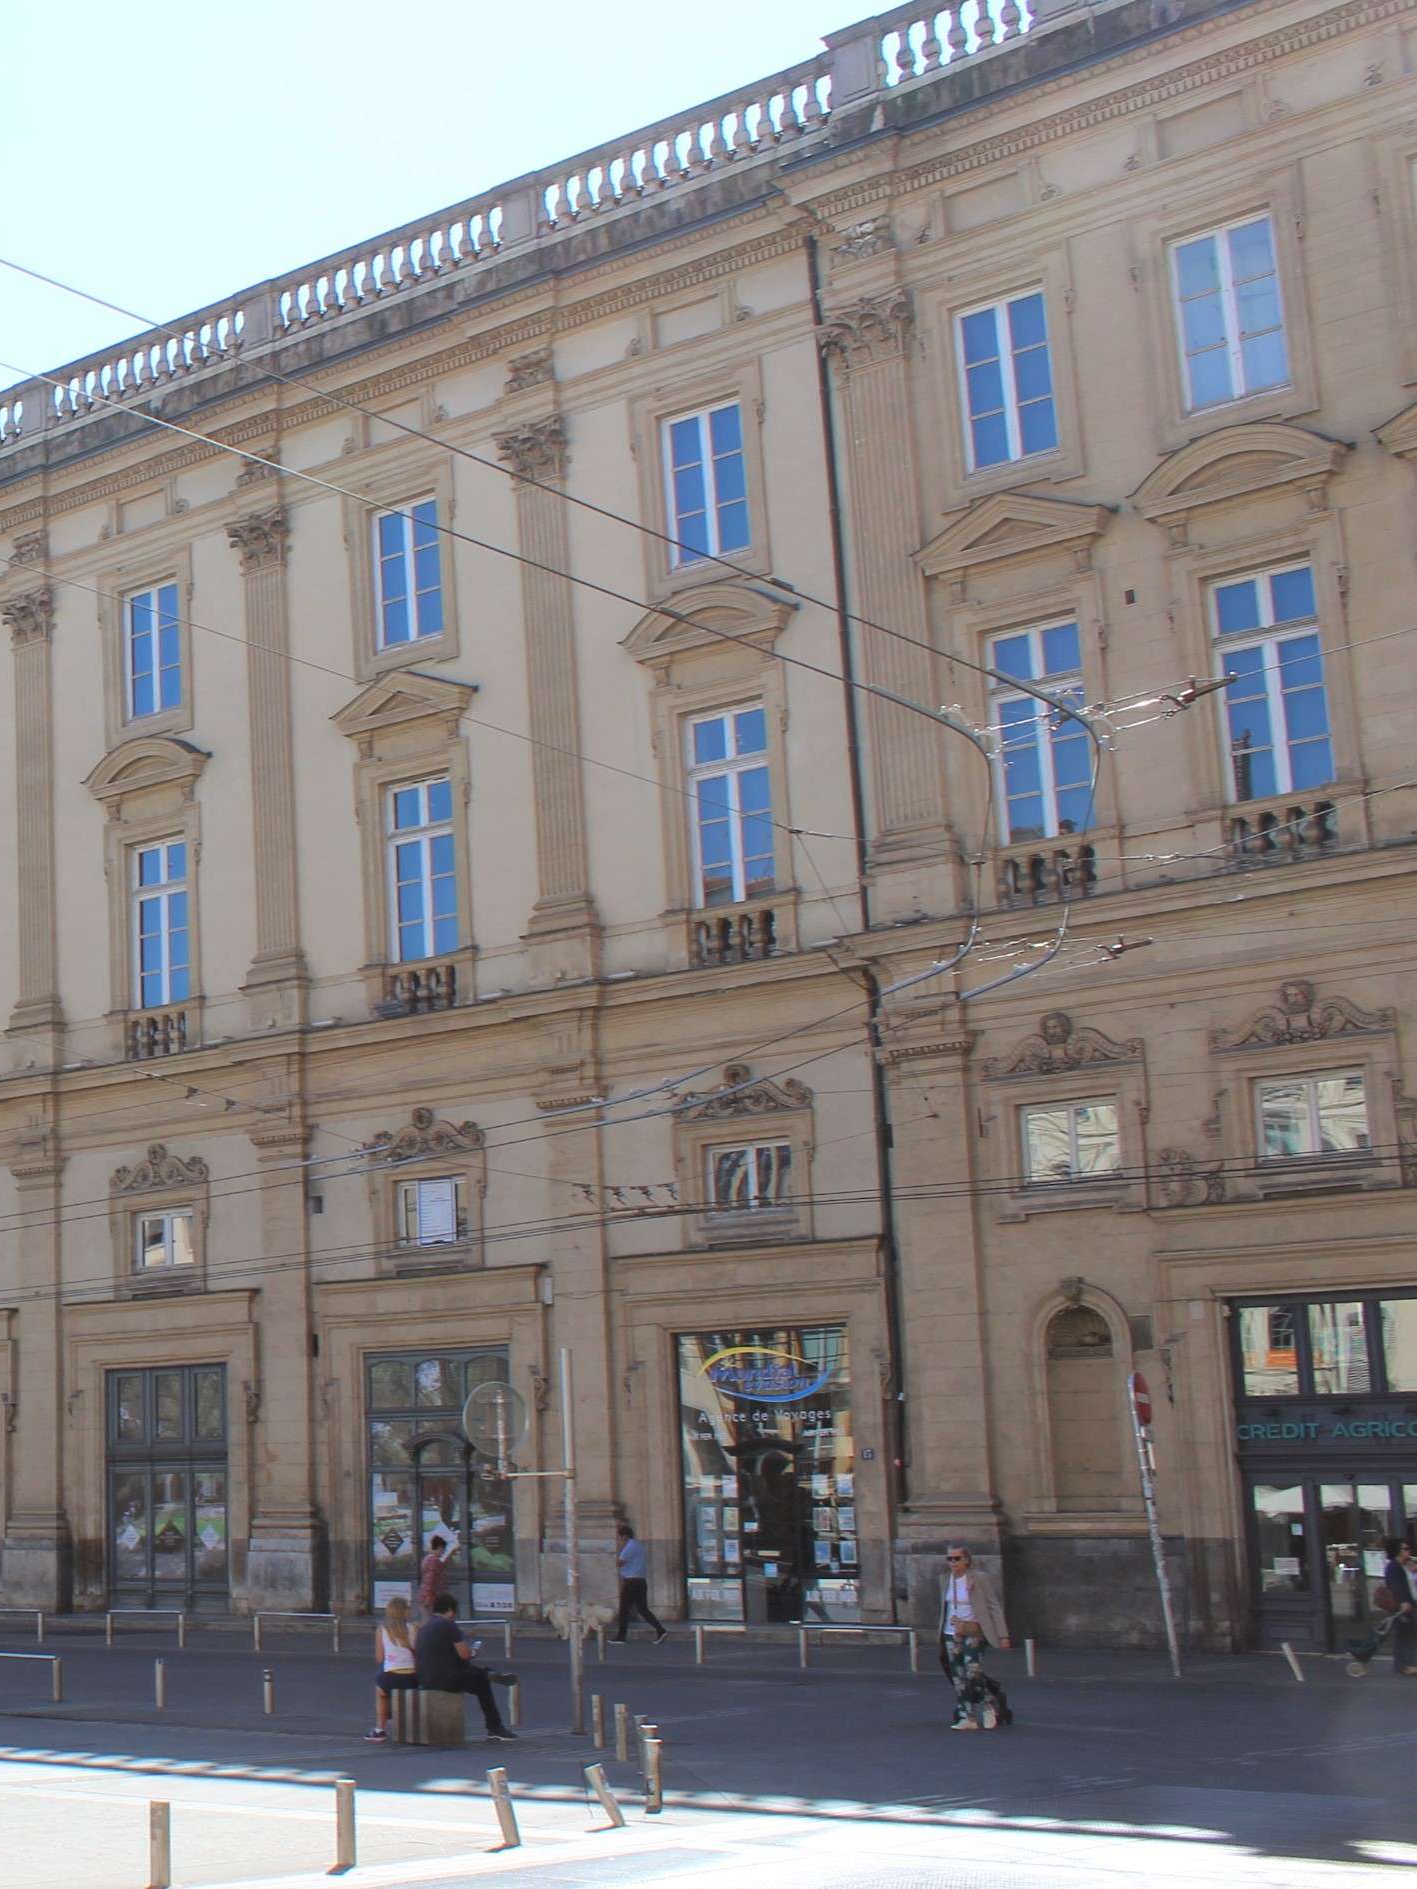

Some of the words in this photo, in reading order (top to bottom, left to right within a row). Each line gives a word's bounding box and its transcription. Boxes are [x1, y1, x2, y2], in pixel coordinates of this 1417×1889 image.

[698, 1410, 746, 1425] Agence
[752, 1409, 769, 1422] de
[774, 1408, 832, 1423] Voyages
